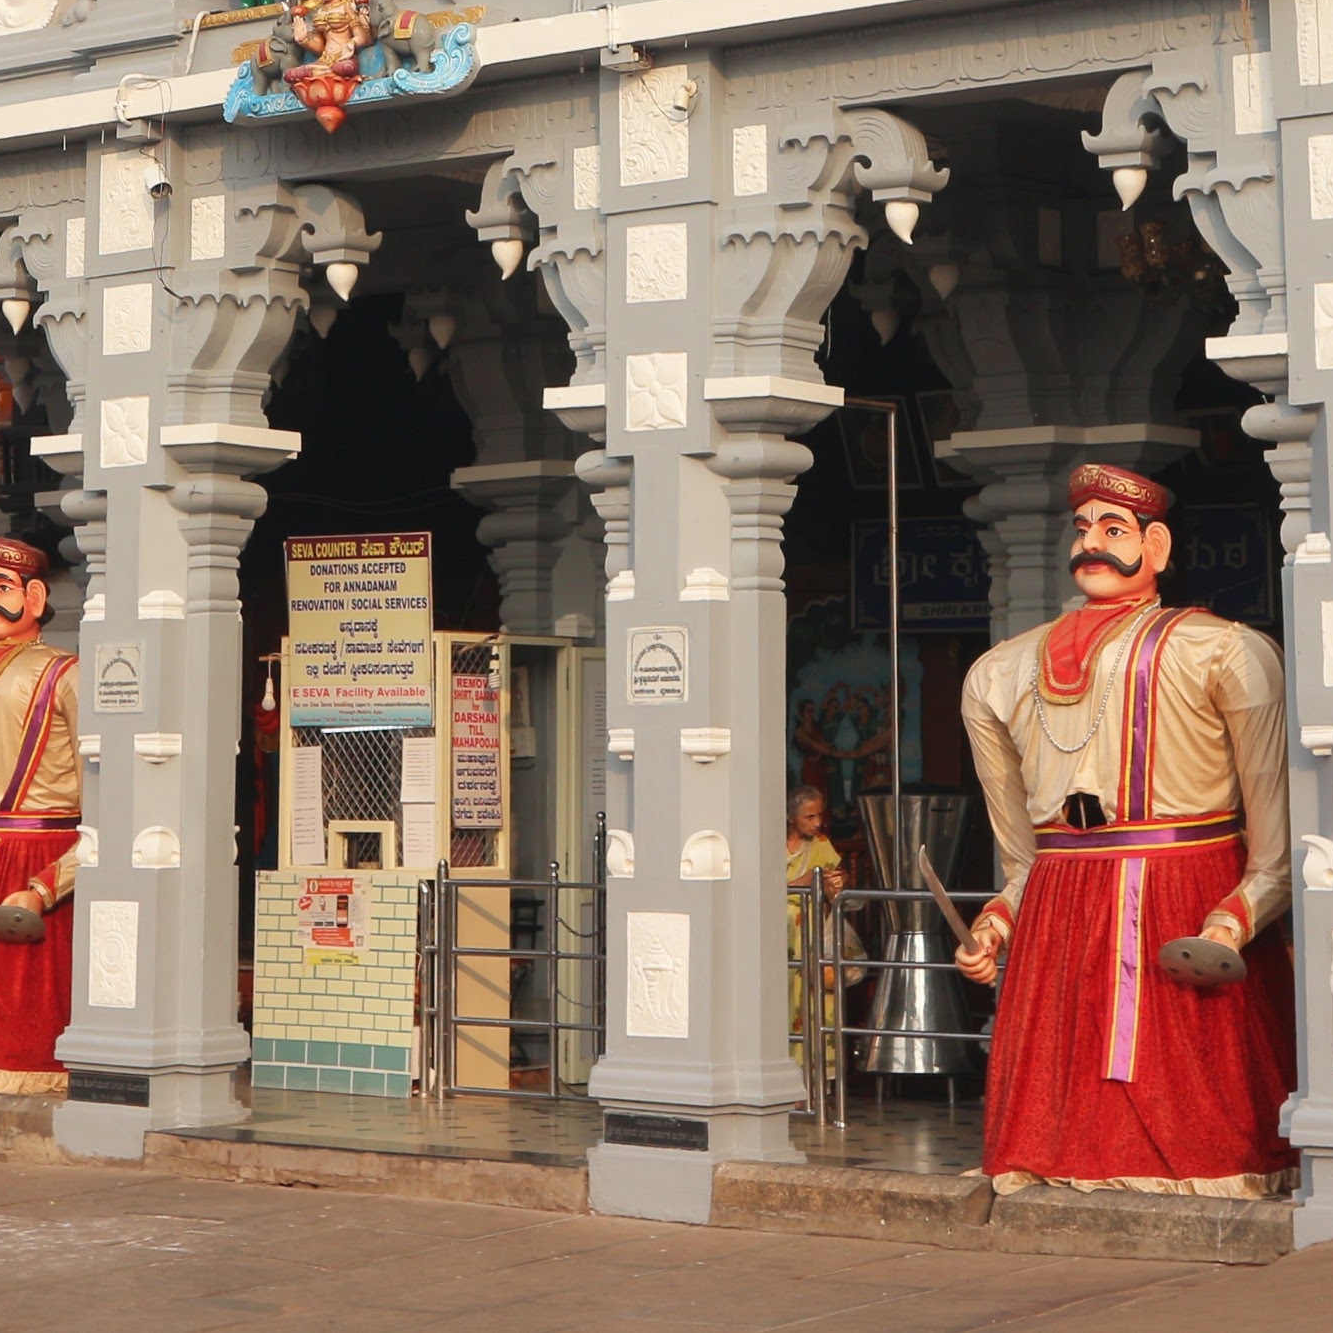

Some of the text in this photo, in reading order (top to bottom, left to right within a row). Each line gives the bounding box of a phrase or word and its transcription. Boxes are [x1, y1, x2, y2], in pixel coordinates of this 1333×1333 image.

[291, 536, 425, 558] SEVA COUNTER ಸೇವಾ ಕೌಂಟರ್
[310, 562, 406, 576] DONATIONS ACCEPTED
[324, 580, 397, 593] FOR ANNADANAM
[291, 599, 344, 611] RENOVATION
[351, 598, 382, 610] SOCIAL
[385, 597, 427, 609] SERVICES
[921, 604, 958, 617] SHRI
[339, 618, 378, 638] ಅನ್ನದಾನಕ್ಕೆ
[457, 678, 490, 688] REMOV
[293, 686, 425, 699] E SEVA Facility Available
[454, 712, 498, 723] DARSHAN
[468, 725, 484, 736] TILL
[452, 737, 500, 748] MAHAPOOJA
